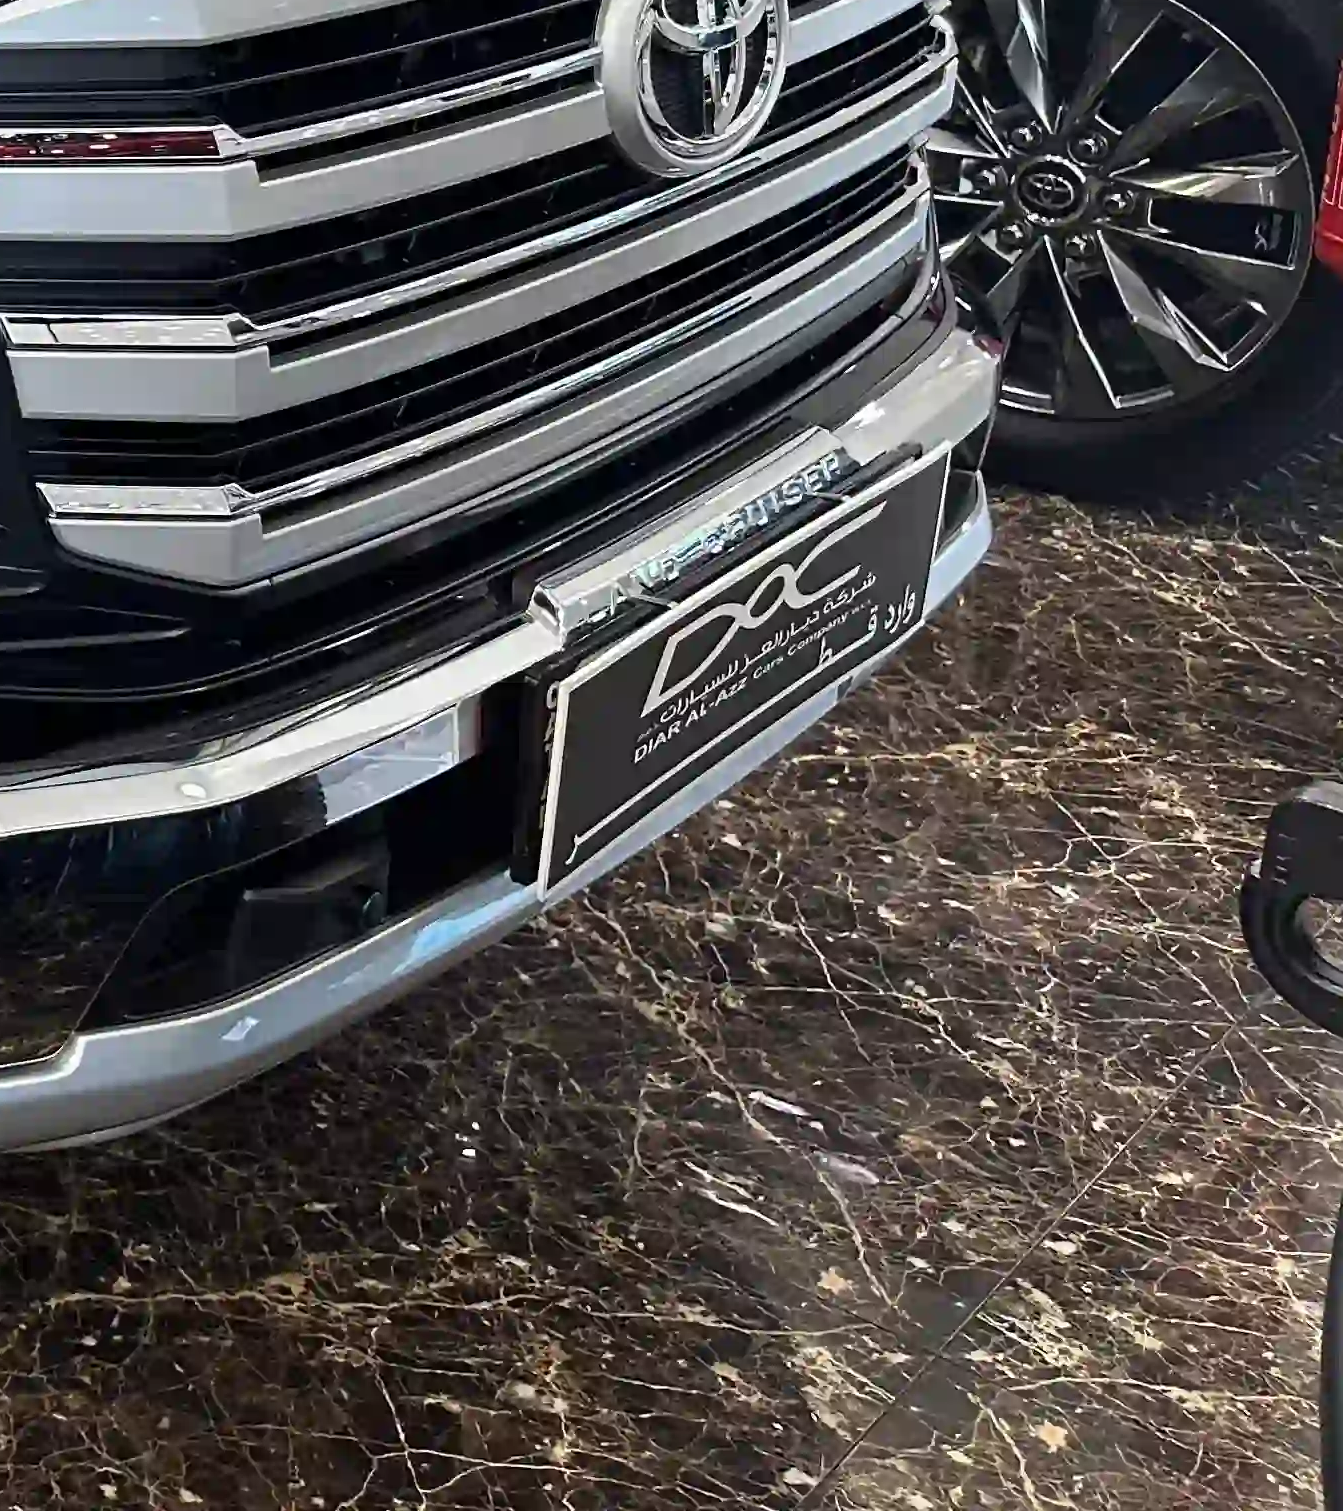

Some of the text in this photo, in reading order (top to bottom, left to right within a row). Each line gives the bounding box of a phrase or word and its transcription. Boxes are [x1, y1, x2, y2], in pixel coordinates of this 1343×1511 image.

[823, 571, 877, 614] شركة
[884, 583, 916, 634] وارد
[634, 720, 681, 764] DIAR
[753, 654, 784, 679] Cars
[787, 611, 849, 656] Company
[660, 659, 739, 723] للسيارات
